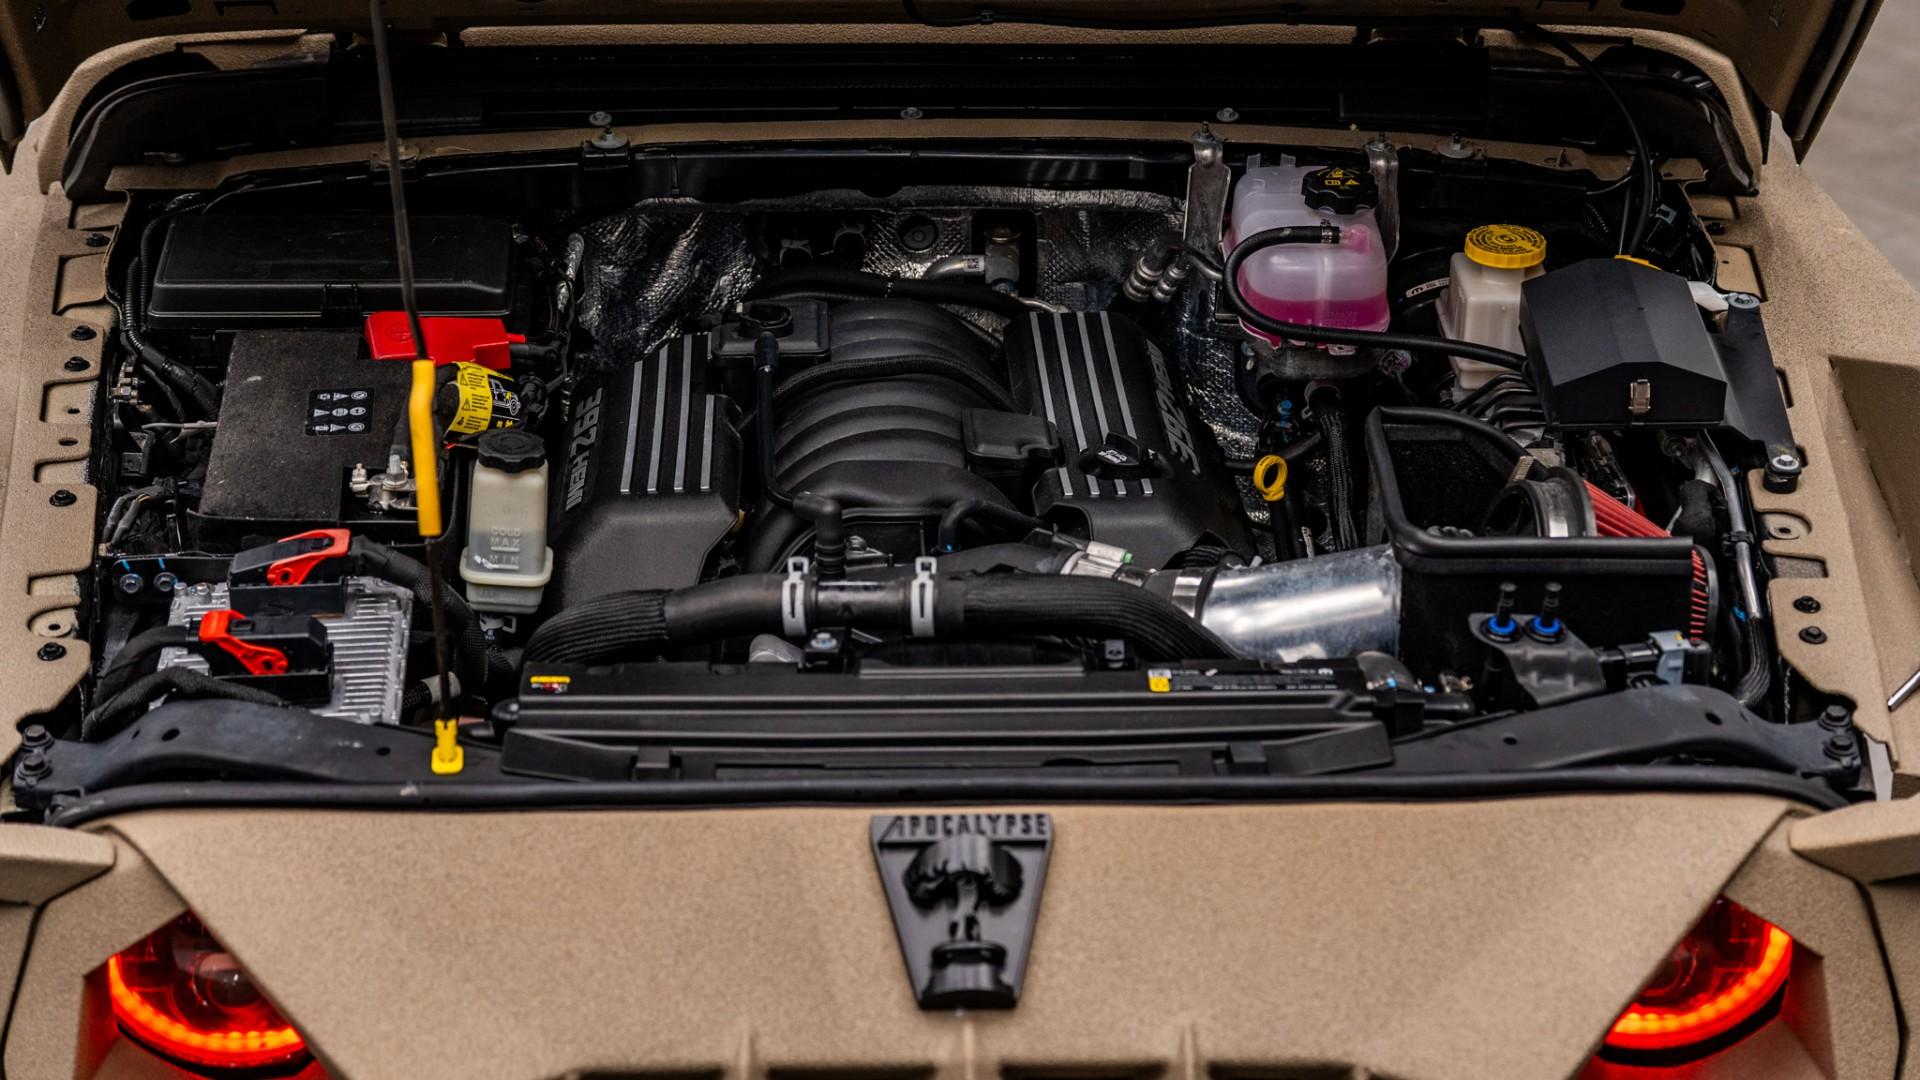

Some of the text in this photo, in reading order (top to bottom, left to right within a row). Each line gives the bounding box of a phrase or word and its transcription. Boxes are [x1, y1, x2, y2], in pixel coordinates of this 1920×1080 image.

[565, 387, 603, 511] 392 HEMI
[491, 527, 521, 537] COLD
[490, 537, 520, 548] MAX
[490, 554, 519, 565] MIN
[881, 813, 1047, 838] APOCALYPSE
